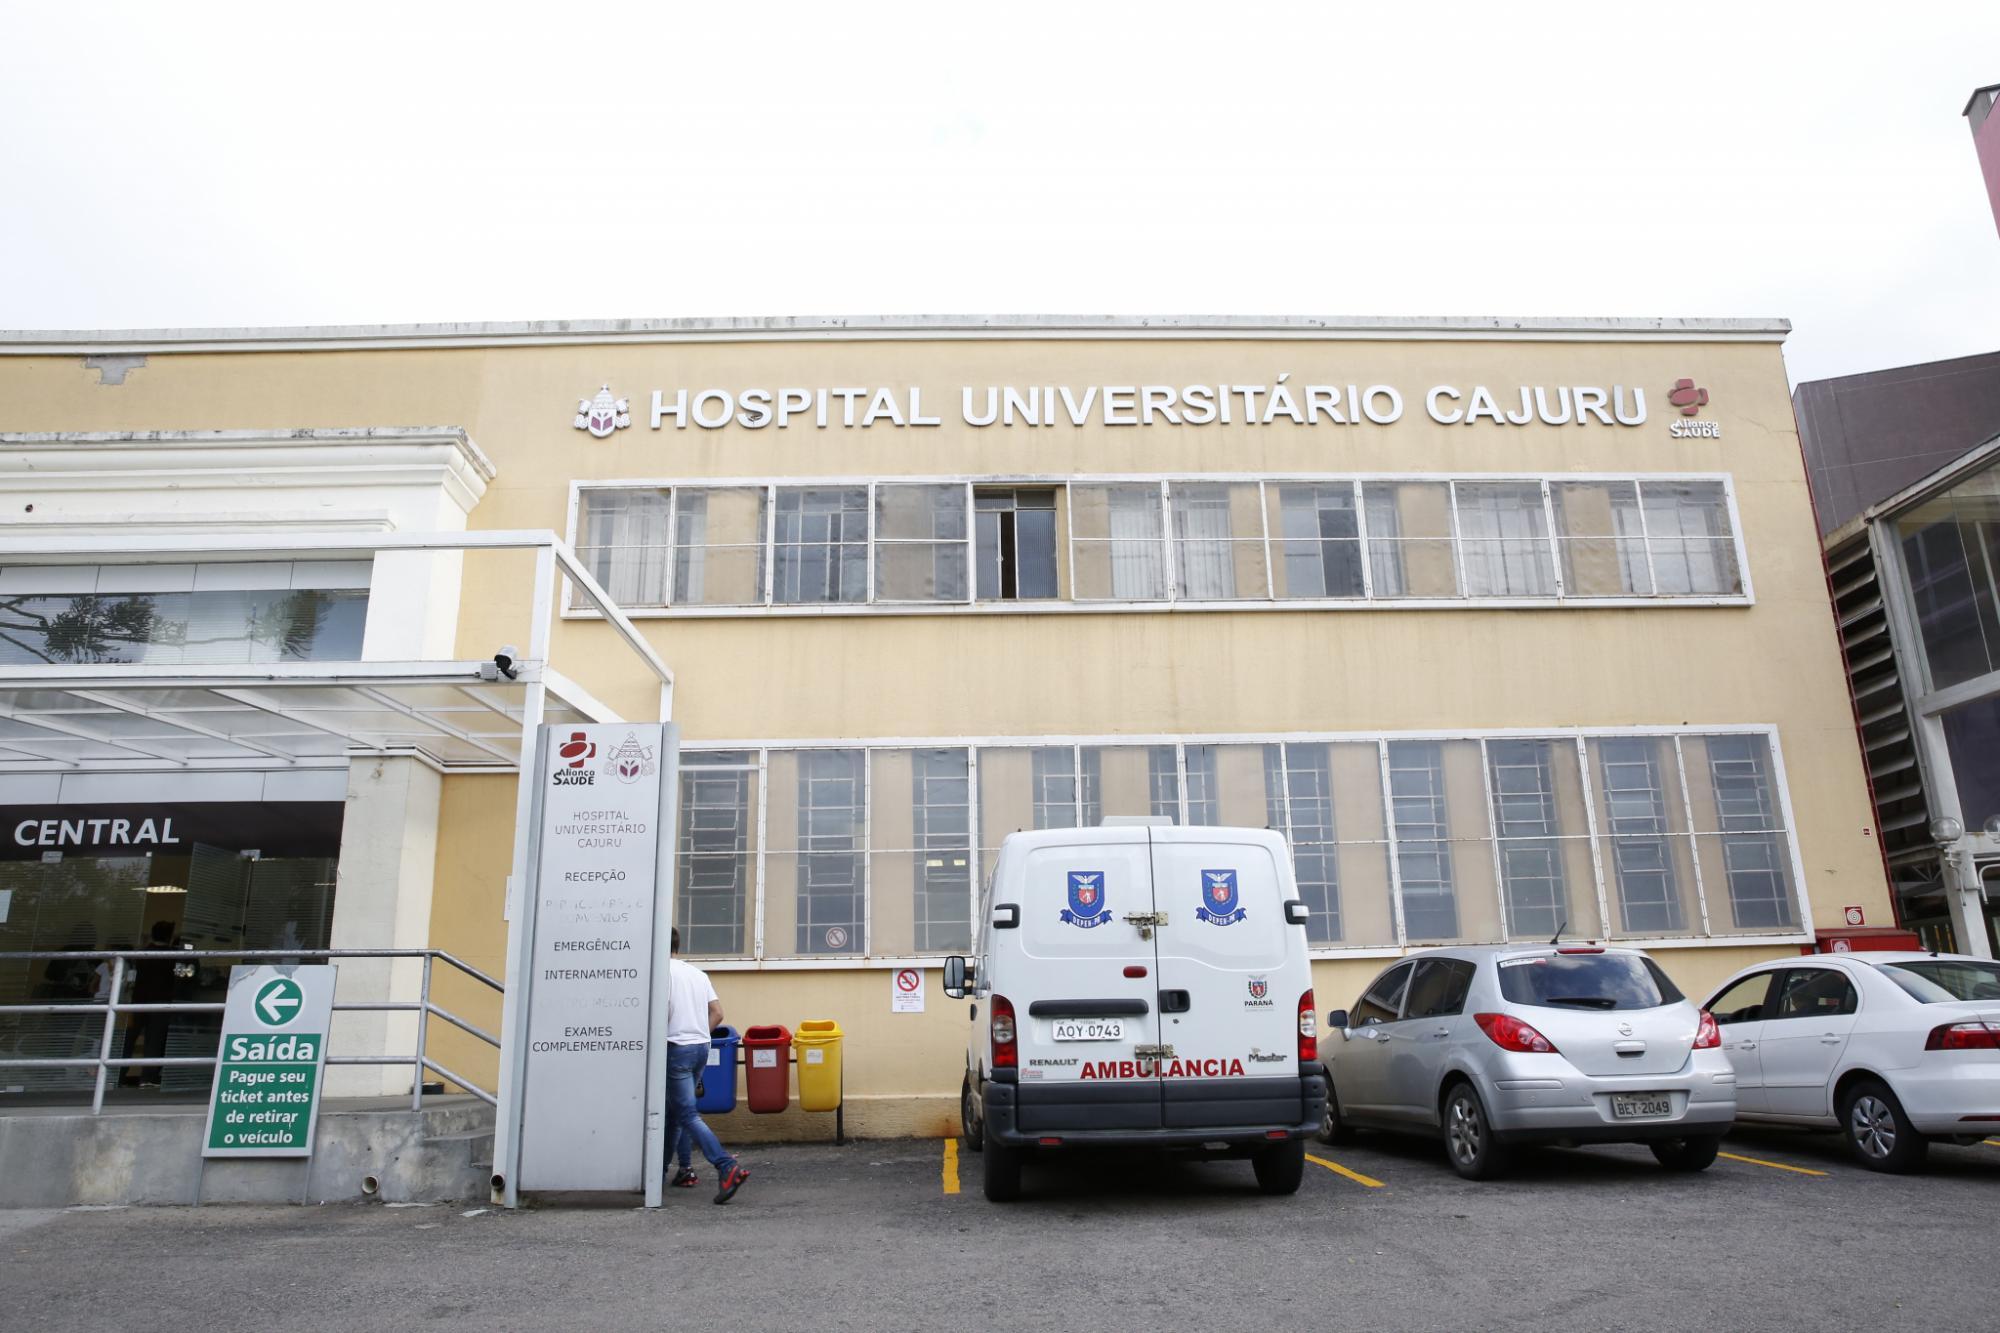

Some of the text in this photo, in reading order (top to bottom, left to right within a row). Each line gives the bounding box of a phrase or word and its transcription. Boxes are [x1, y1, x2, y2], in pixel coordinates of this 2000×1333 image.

[651, 373, 1648, 430] HOSPITAL UNIVERSITÁRIO CAJURU
[573, 810, 630, 822] HOSPITAL
[14, 818, 180, 847] CENTRAL
[555, 821, 647, 835] UNIVERSITÁRIO
[577, 838, 623, 849] CAJURU
[564, 868, 627, 884] RECEPÇÃO
[554, 938, 631, 952] EMERGÊNCIA
[544, 968, 638, 980] INTERNAMENTO
[564, 1026, 613, 1037] EXAMES
[229, 1036, 315, 1062] Saída
[532, 1040, 644, 1052] COMPLEMENTARES
[1029, 1058, 1079, 1067] RENAULT
[1080, 1055, 1245, 1079] AMBULÂNCIA
[229, 1070, 306, 1086] Pague seu
[220, 1090, 310, 1104] ticket antes
[225, 1110, 299, 1124] de retirar
[224, 1130, 294, 1145] o veículo
